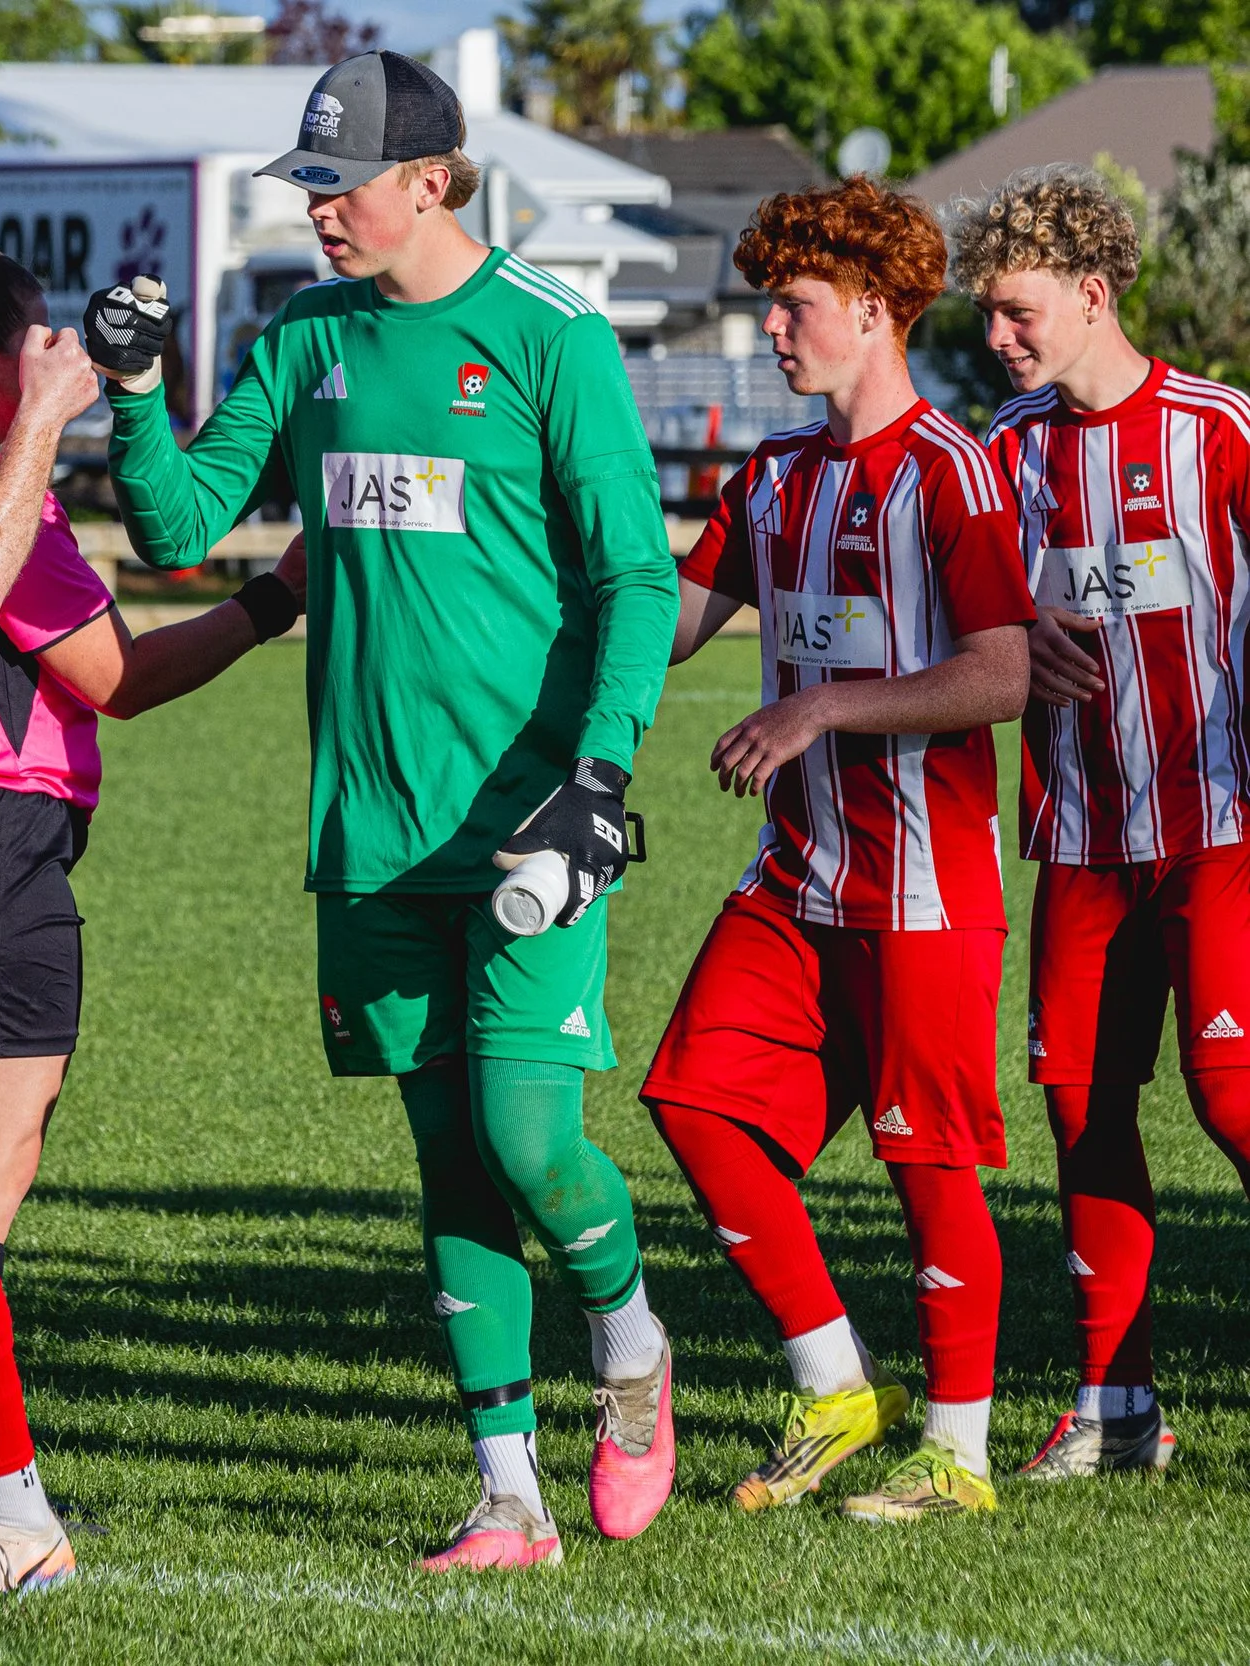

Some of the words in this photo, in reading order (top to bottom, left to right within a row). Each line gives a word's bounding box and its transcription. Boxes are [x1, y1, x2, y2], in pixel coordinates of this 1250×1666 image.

[306, 112, 319, 124] TOP
[320, 114, 341, 128] CAT
[448, 408, 487, 418] FOOTBALL
[1124, 500, 1162, 512] FOOTBALL
[403, 520, 432, 528] Services
[837, 541, 876, 552] FOOTBALL
[825, 657, 852, 665] Services
[559, 1024, 591, 1039] adidas
[1202, 1027, 1244, 1039] adidas
[874, 1121, 914, 1136] adidas
